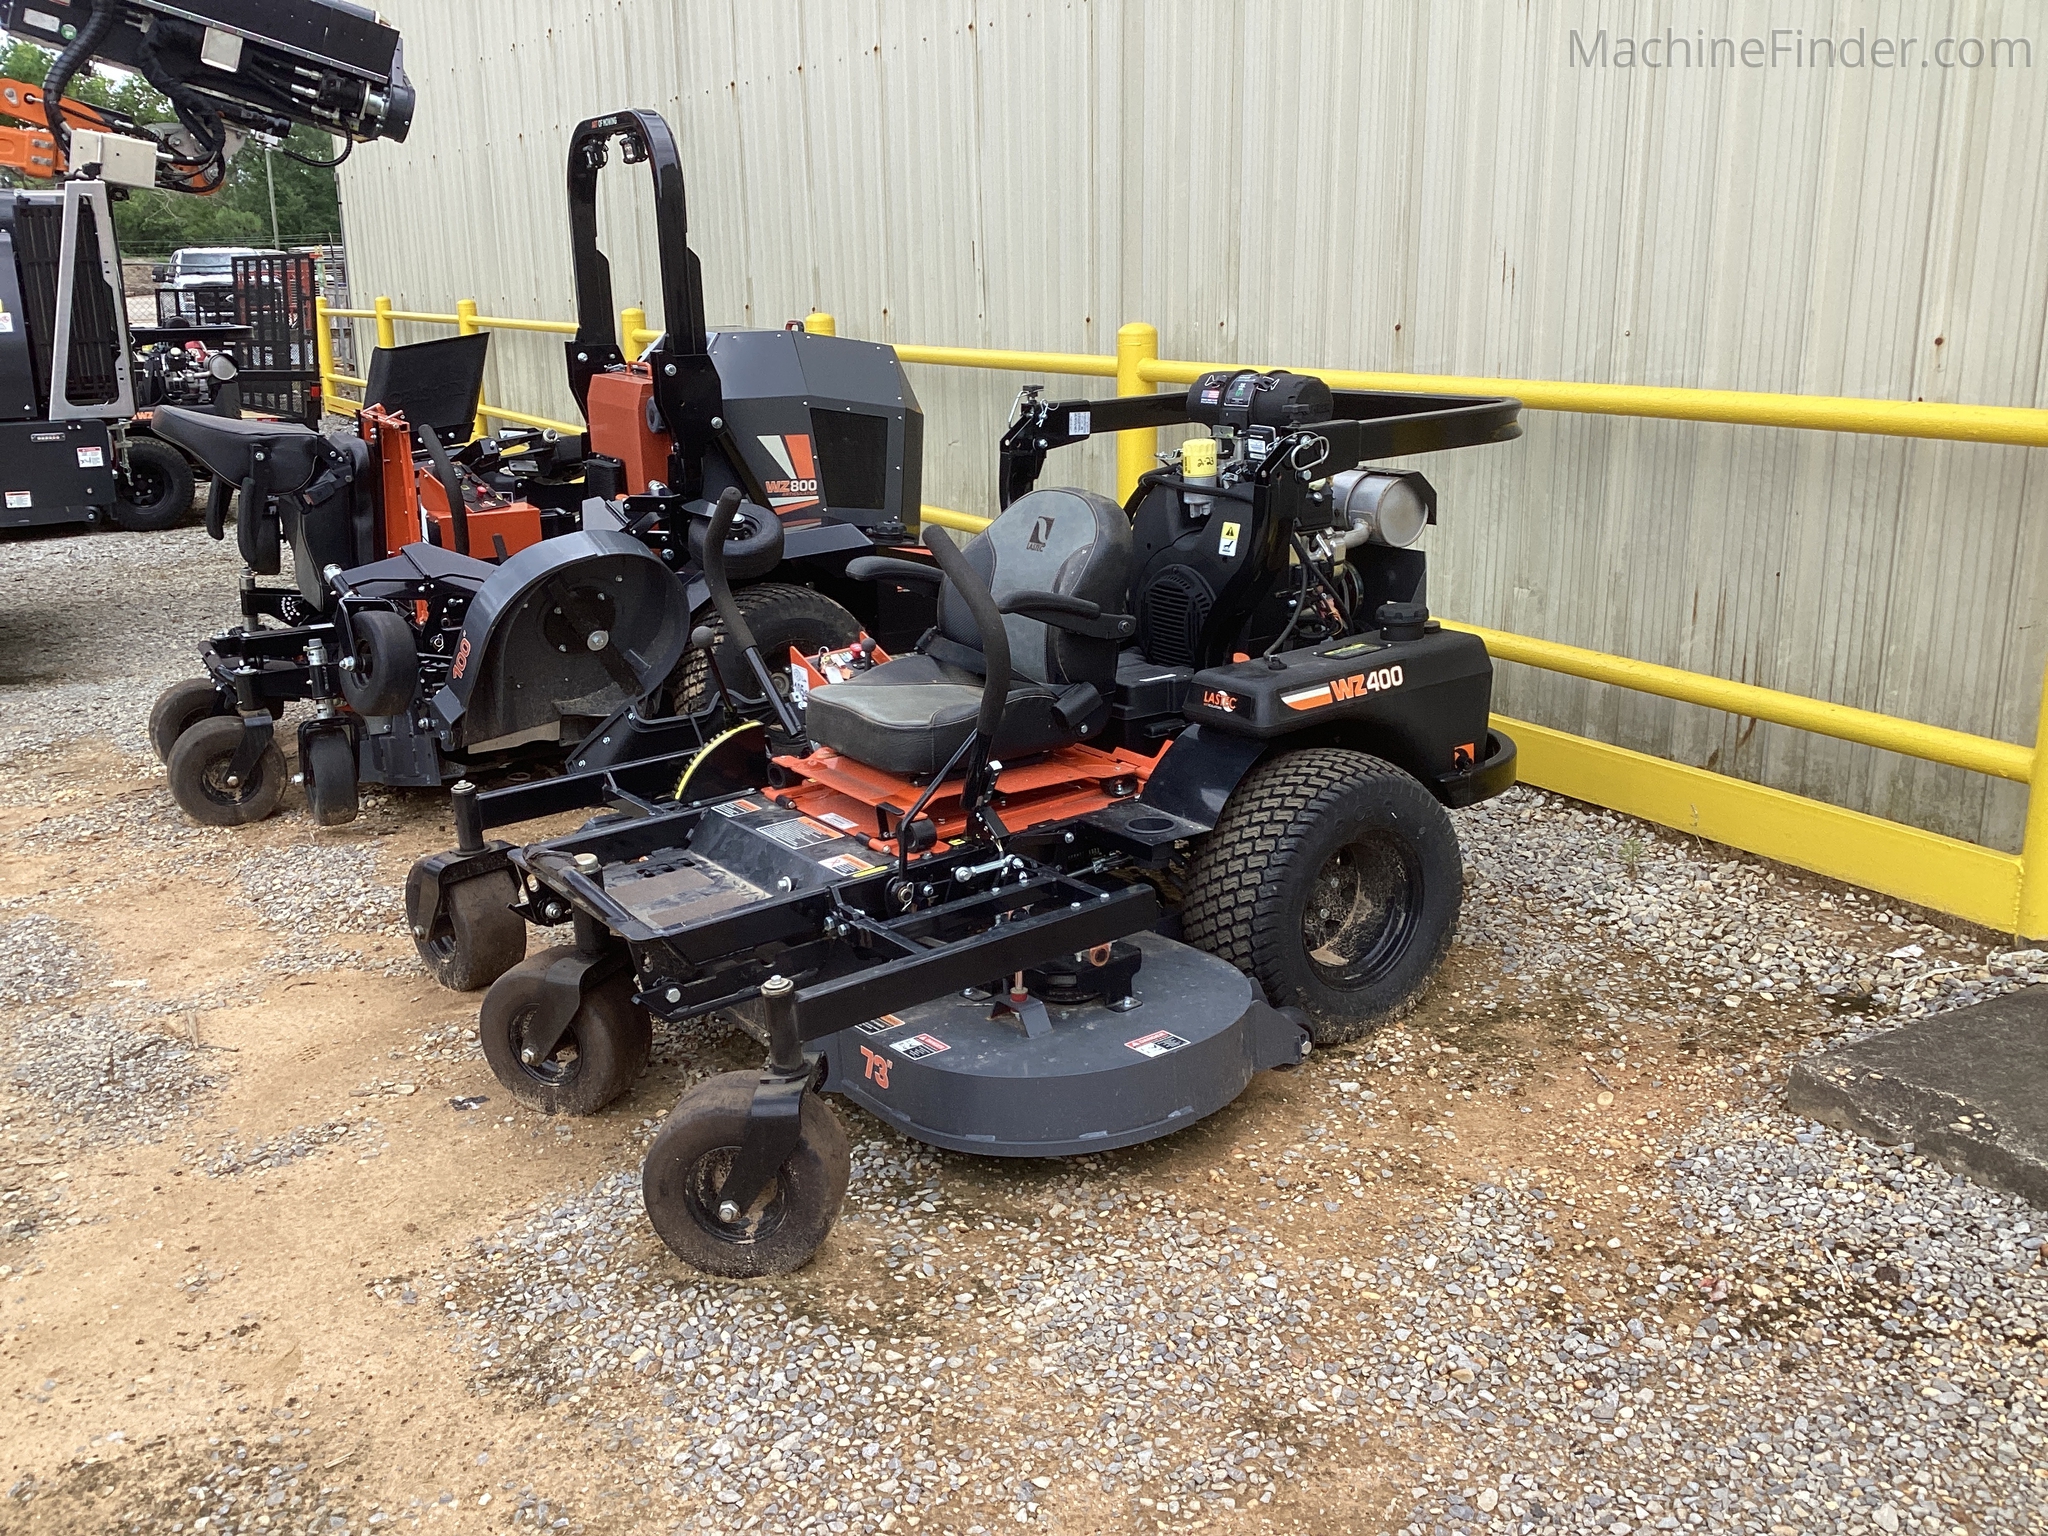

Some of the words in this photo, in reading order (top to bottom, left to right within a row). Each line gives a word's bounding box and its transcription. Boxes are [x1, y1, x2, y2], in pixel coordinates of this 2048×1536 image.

[765, 480, 817, 493] WZ800
[1329, 665, 1404, 702] WZ400
[1203, 690, 1237, 710] LASTEC
